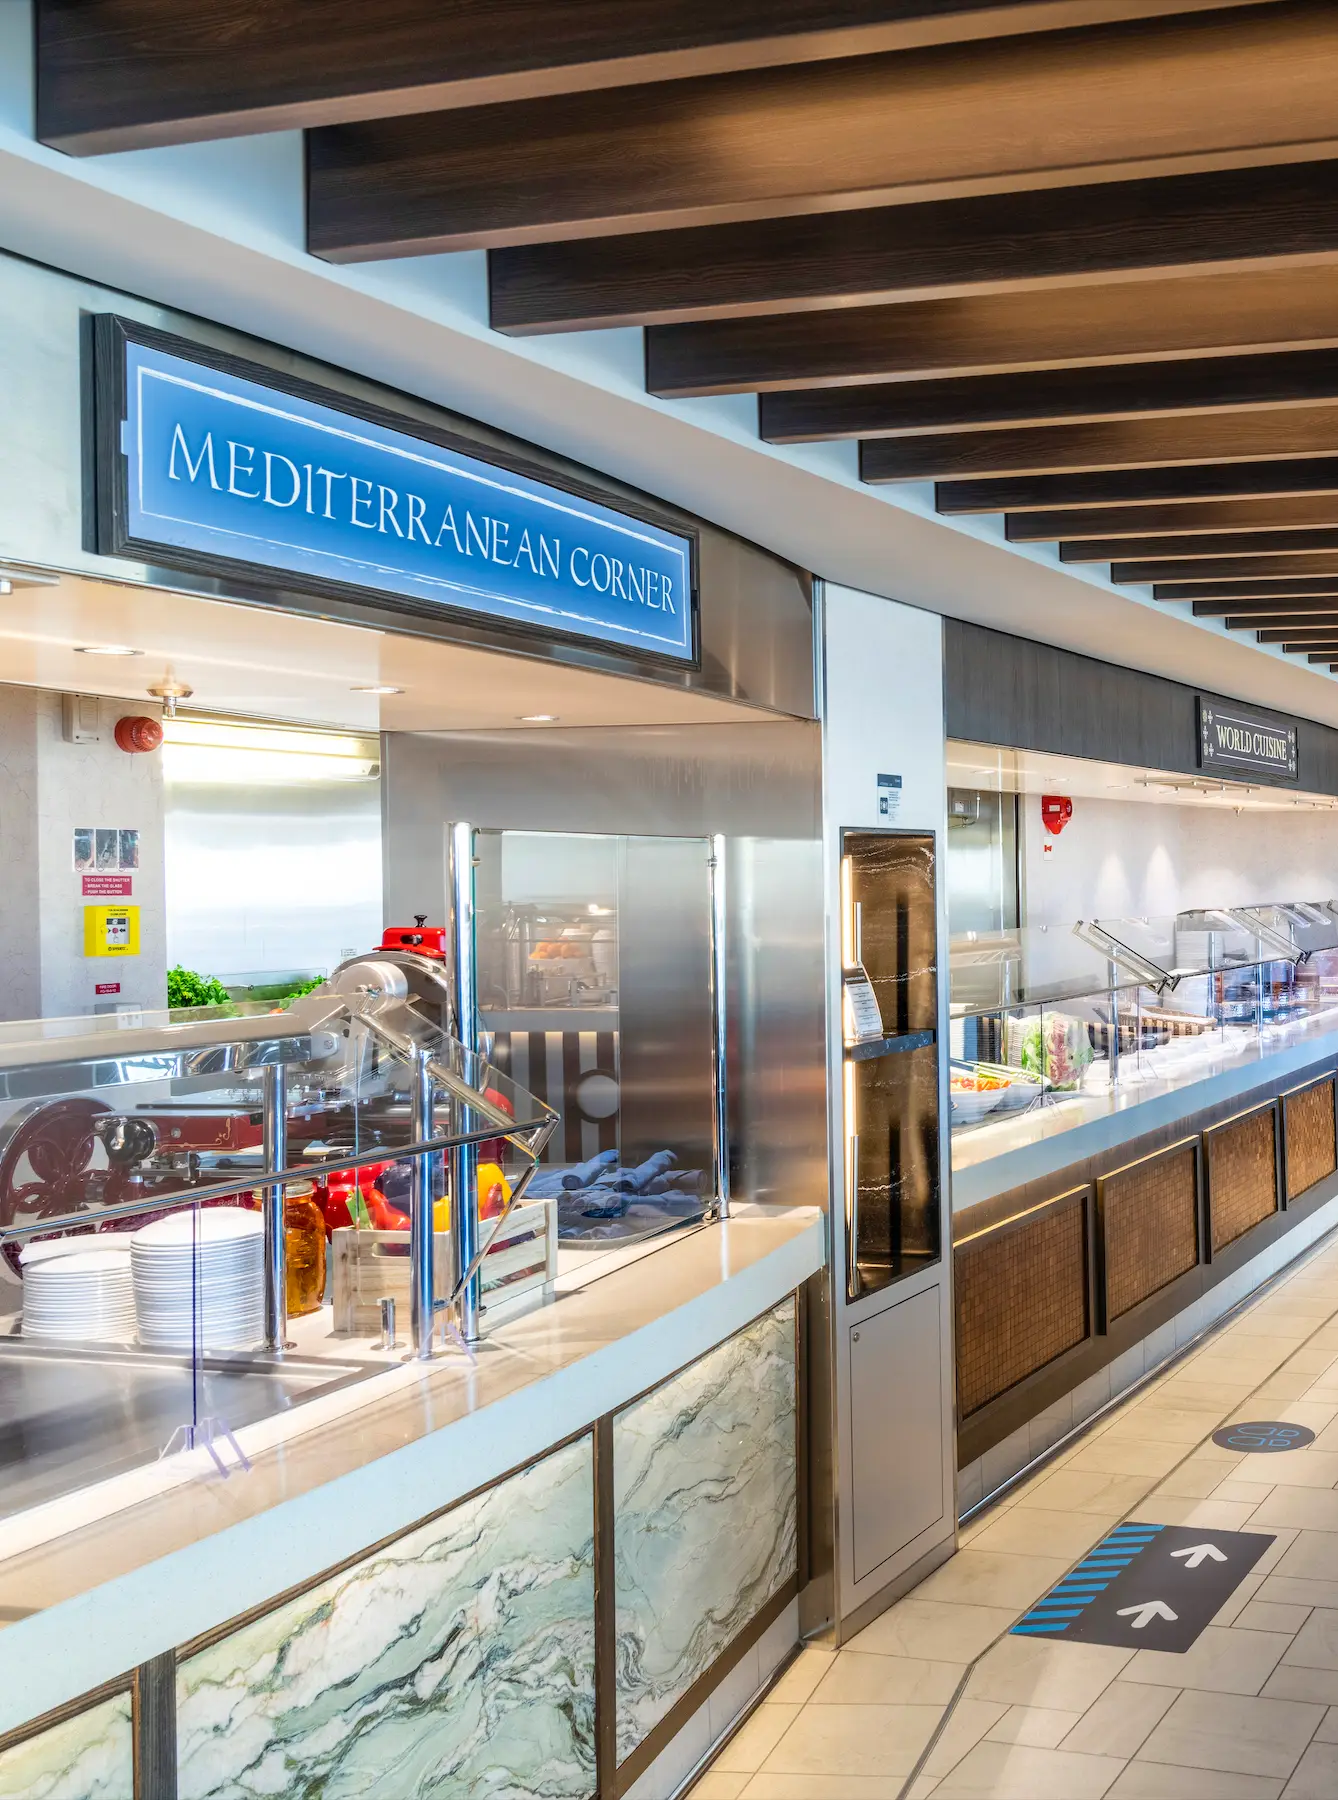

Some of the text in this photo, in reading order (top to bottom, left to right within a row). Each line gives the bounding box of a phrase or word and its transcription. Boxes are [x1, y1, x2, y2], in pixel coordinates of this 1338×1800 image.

[168, 422, 677, 615] MEDITERRANEAN CORNER
[1216, 724, 1287, 761] WORLD CUISINE
